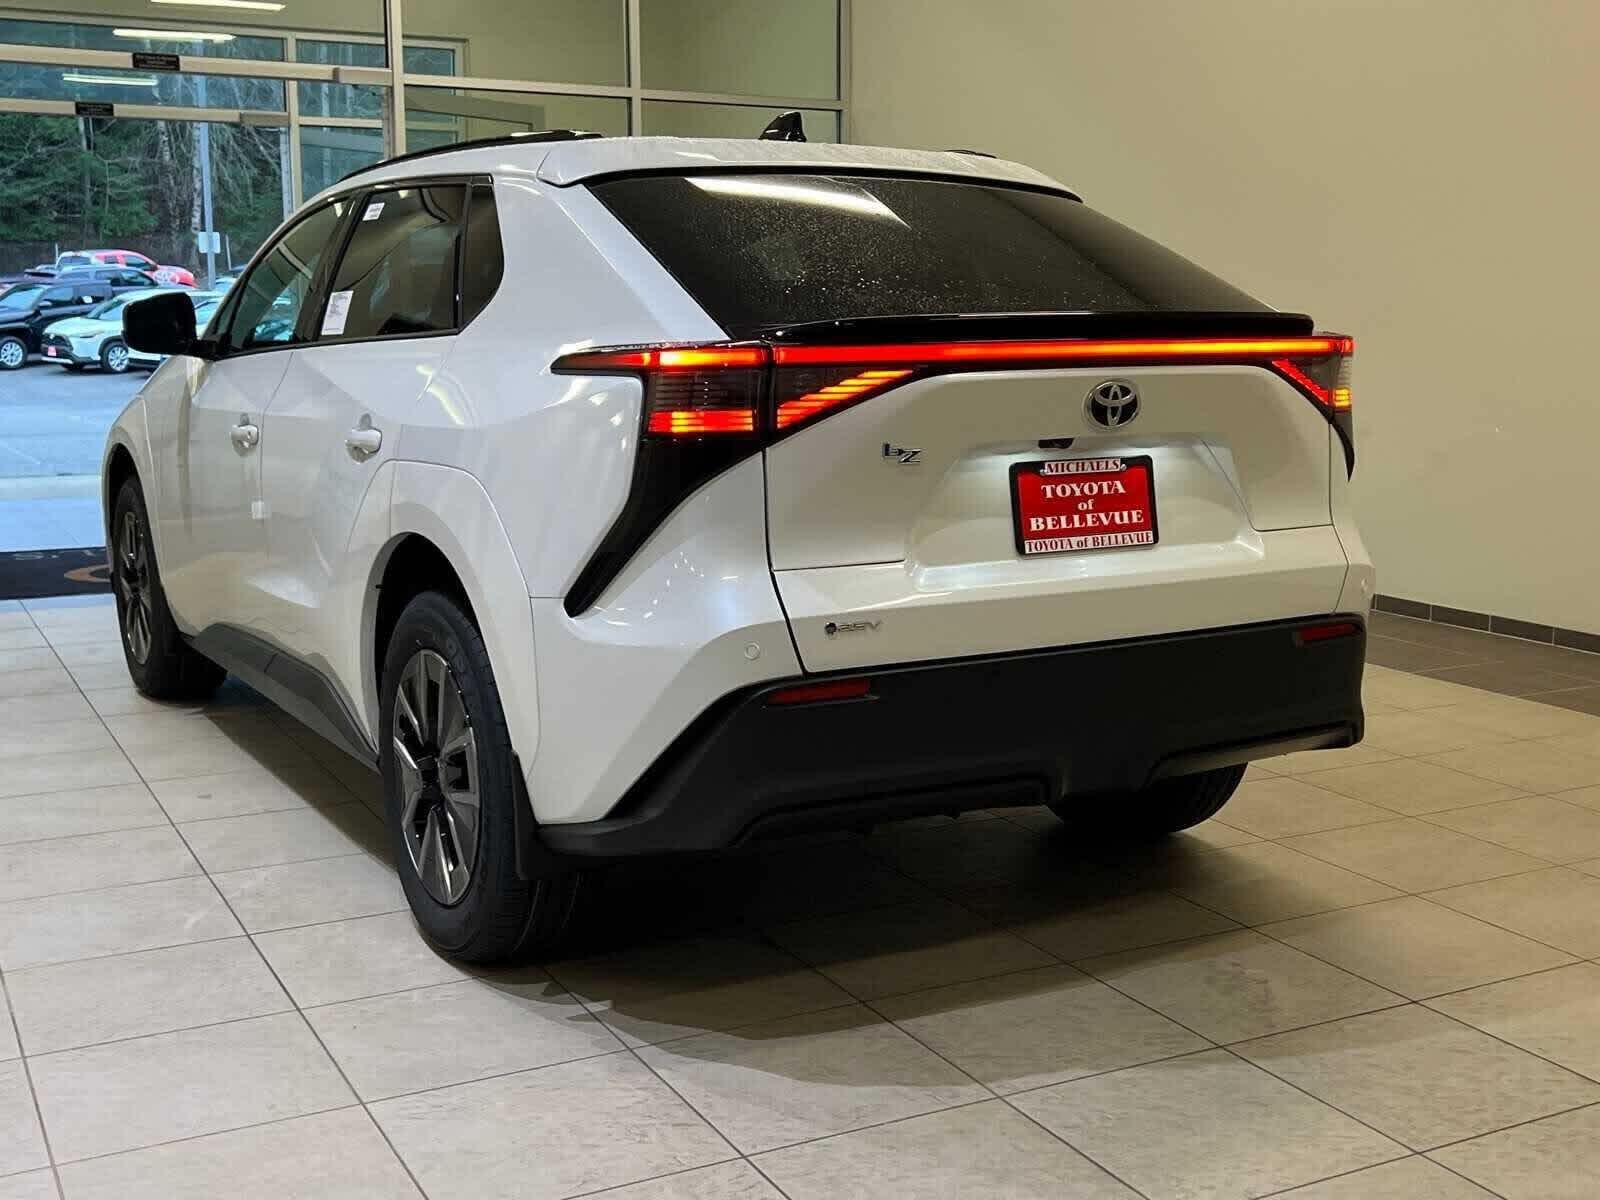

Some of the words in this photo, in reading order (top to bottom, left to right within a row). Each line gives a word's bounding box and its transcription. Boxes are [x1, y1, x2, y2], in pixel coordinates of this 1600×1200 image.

[1046, 459, 1120, 474] MICHAELS
[1041, 480, 1126, 499] TOYOTA
[1077, 499, 1095, 511] of
[1030, 510, 1144, 531] BELLEVUE
[1026, 538, 1073, 553] TOYOTA
[1076, 537, 1089, 549] of
[1092, 531, 1152, 547] BELLEVUE
